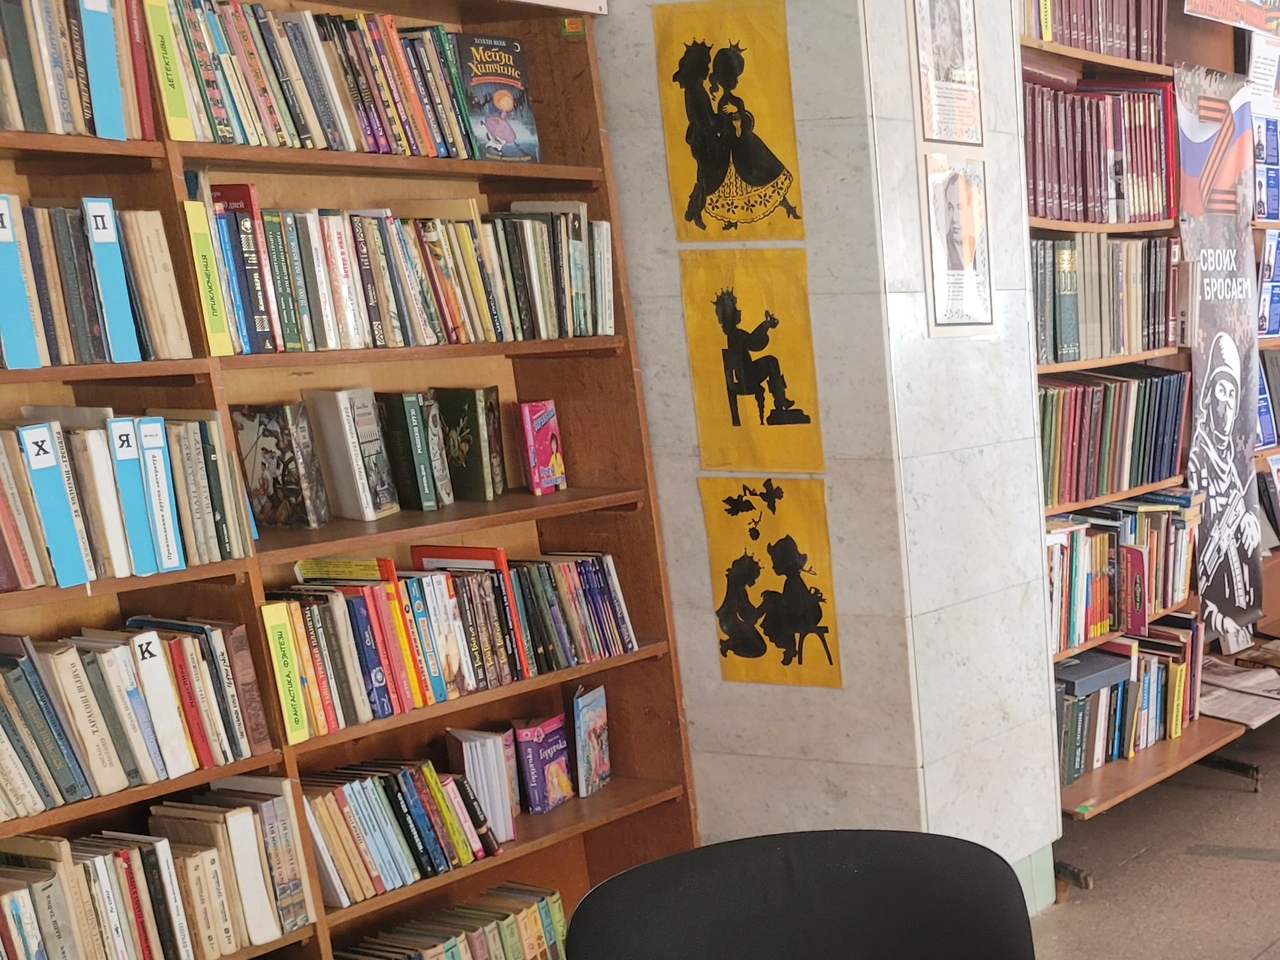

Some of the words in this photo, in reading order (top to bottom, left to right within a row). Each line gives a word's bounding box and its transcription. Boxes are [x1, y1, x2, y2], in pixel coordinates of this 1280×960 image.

[158, 34, 175, 89] ДЕТЕКТИВЫ
[471, 46, 514, 66] Мейзи
[468, 62, 521, 79] Хитчинс
[92, 215, 108, 230] П
[1200, 248, 1237, 272] СВОИХ
[201, 255, 219, 316] ПРИКЛЮЧЕНИЯ
[1203, 276, 1252, 301] БРОСАЕМ
[32, 439, 50, 457] Х
[118, 433, 133, 449] Я
[160, 514, 172, 560] Произведения
[306, 611, 320, 646] ПЛАНЕТЫ
[138, 641, 157, 661] К
[277, 631, 289, 667] ФЭНТЕЗИ
[314, 649, 327, 678] ТРЕТЬЕЙ
[286, 671, 300, 724] ФАНТАСТИКА,
[322, 681, 330, 704] ТАЙНА
